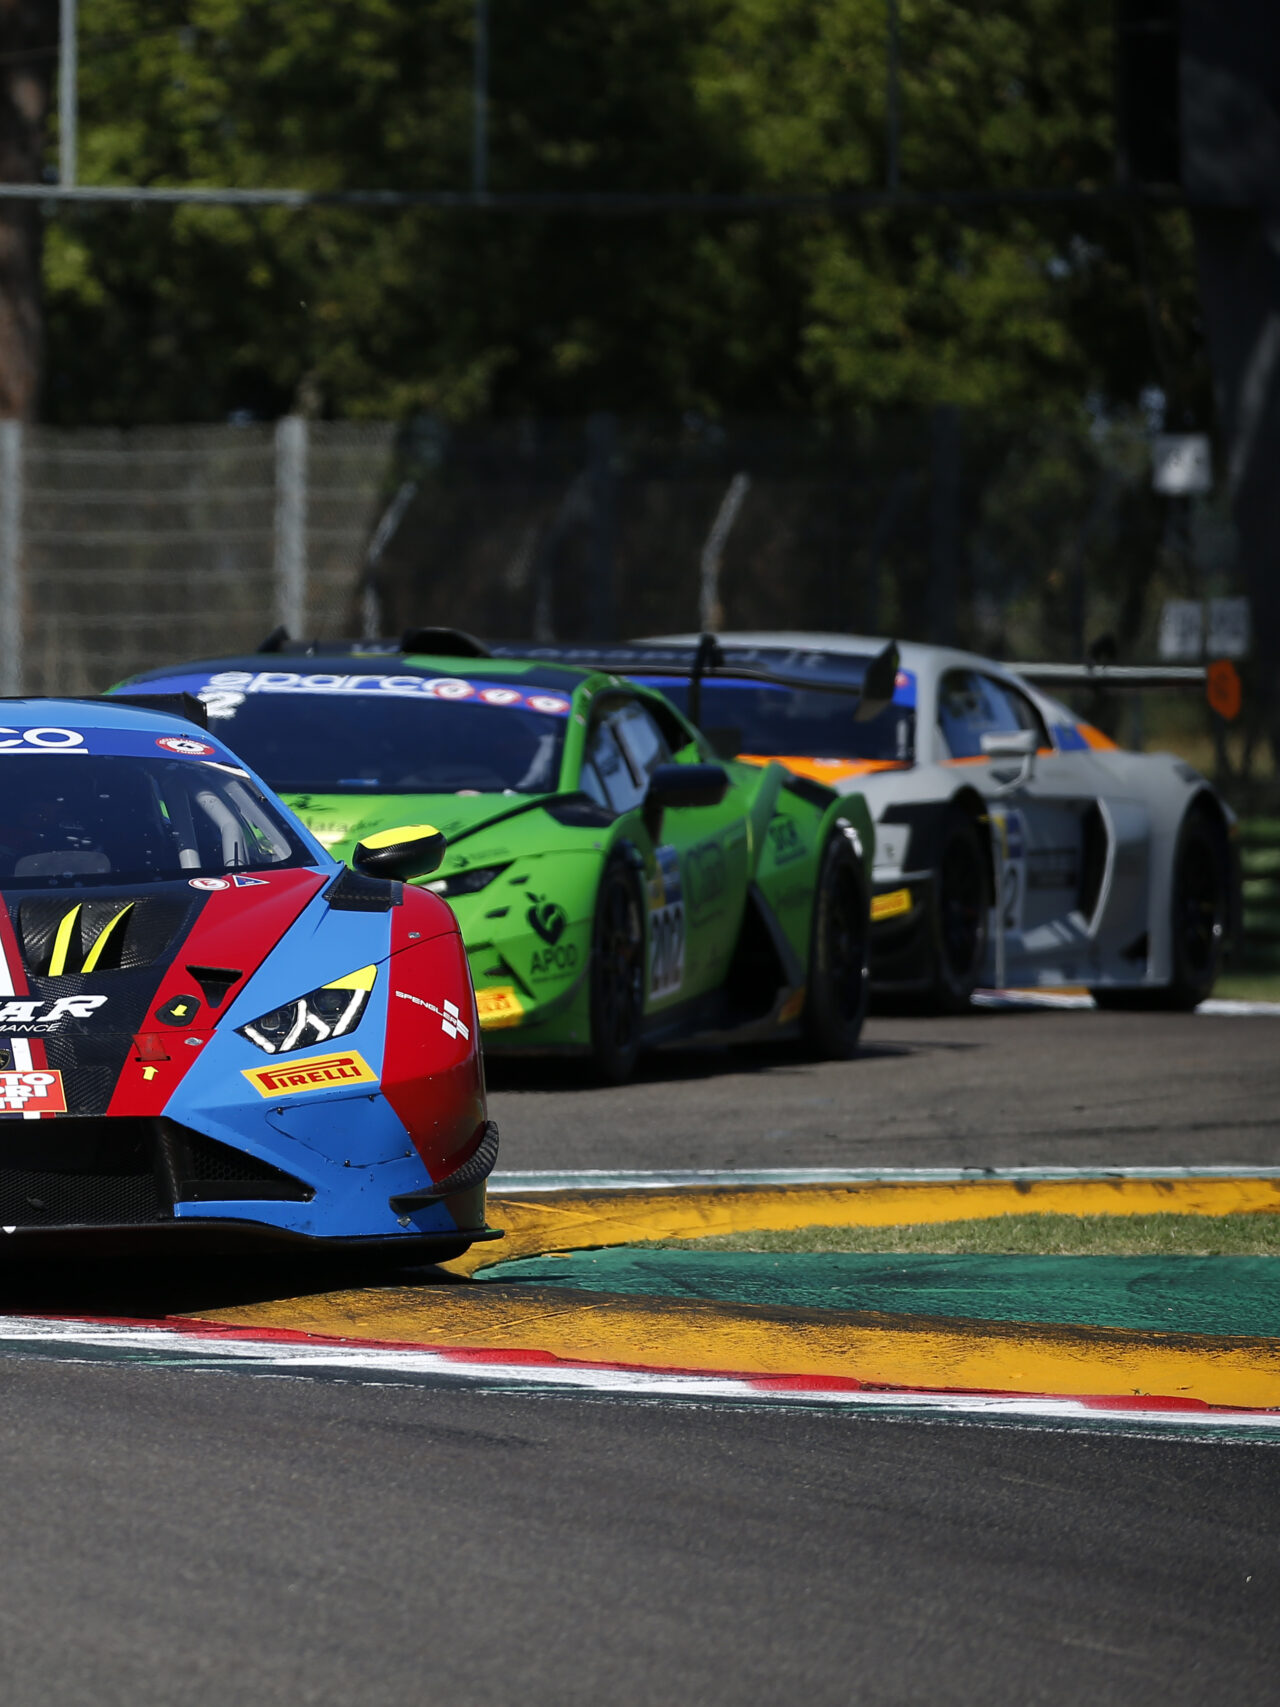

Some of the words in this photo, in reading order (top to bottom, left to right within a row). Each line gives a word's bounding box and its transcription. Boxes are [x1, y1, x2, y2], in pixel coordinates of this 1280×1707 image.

[203, 671, 472, 699] sparco
[530, 943, 578, 976] APOD
[650, 905, 682, 993] 202
[395, 990, 458, 1025] SPENGLER
[256, 1057, 362, 1091] PIRELLI
